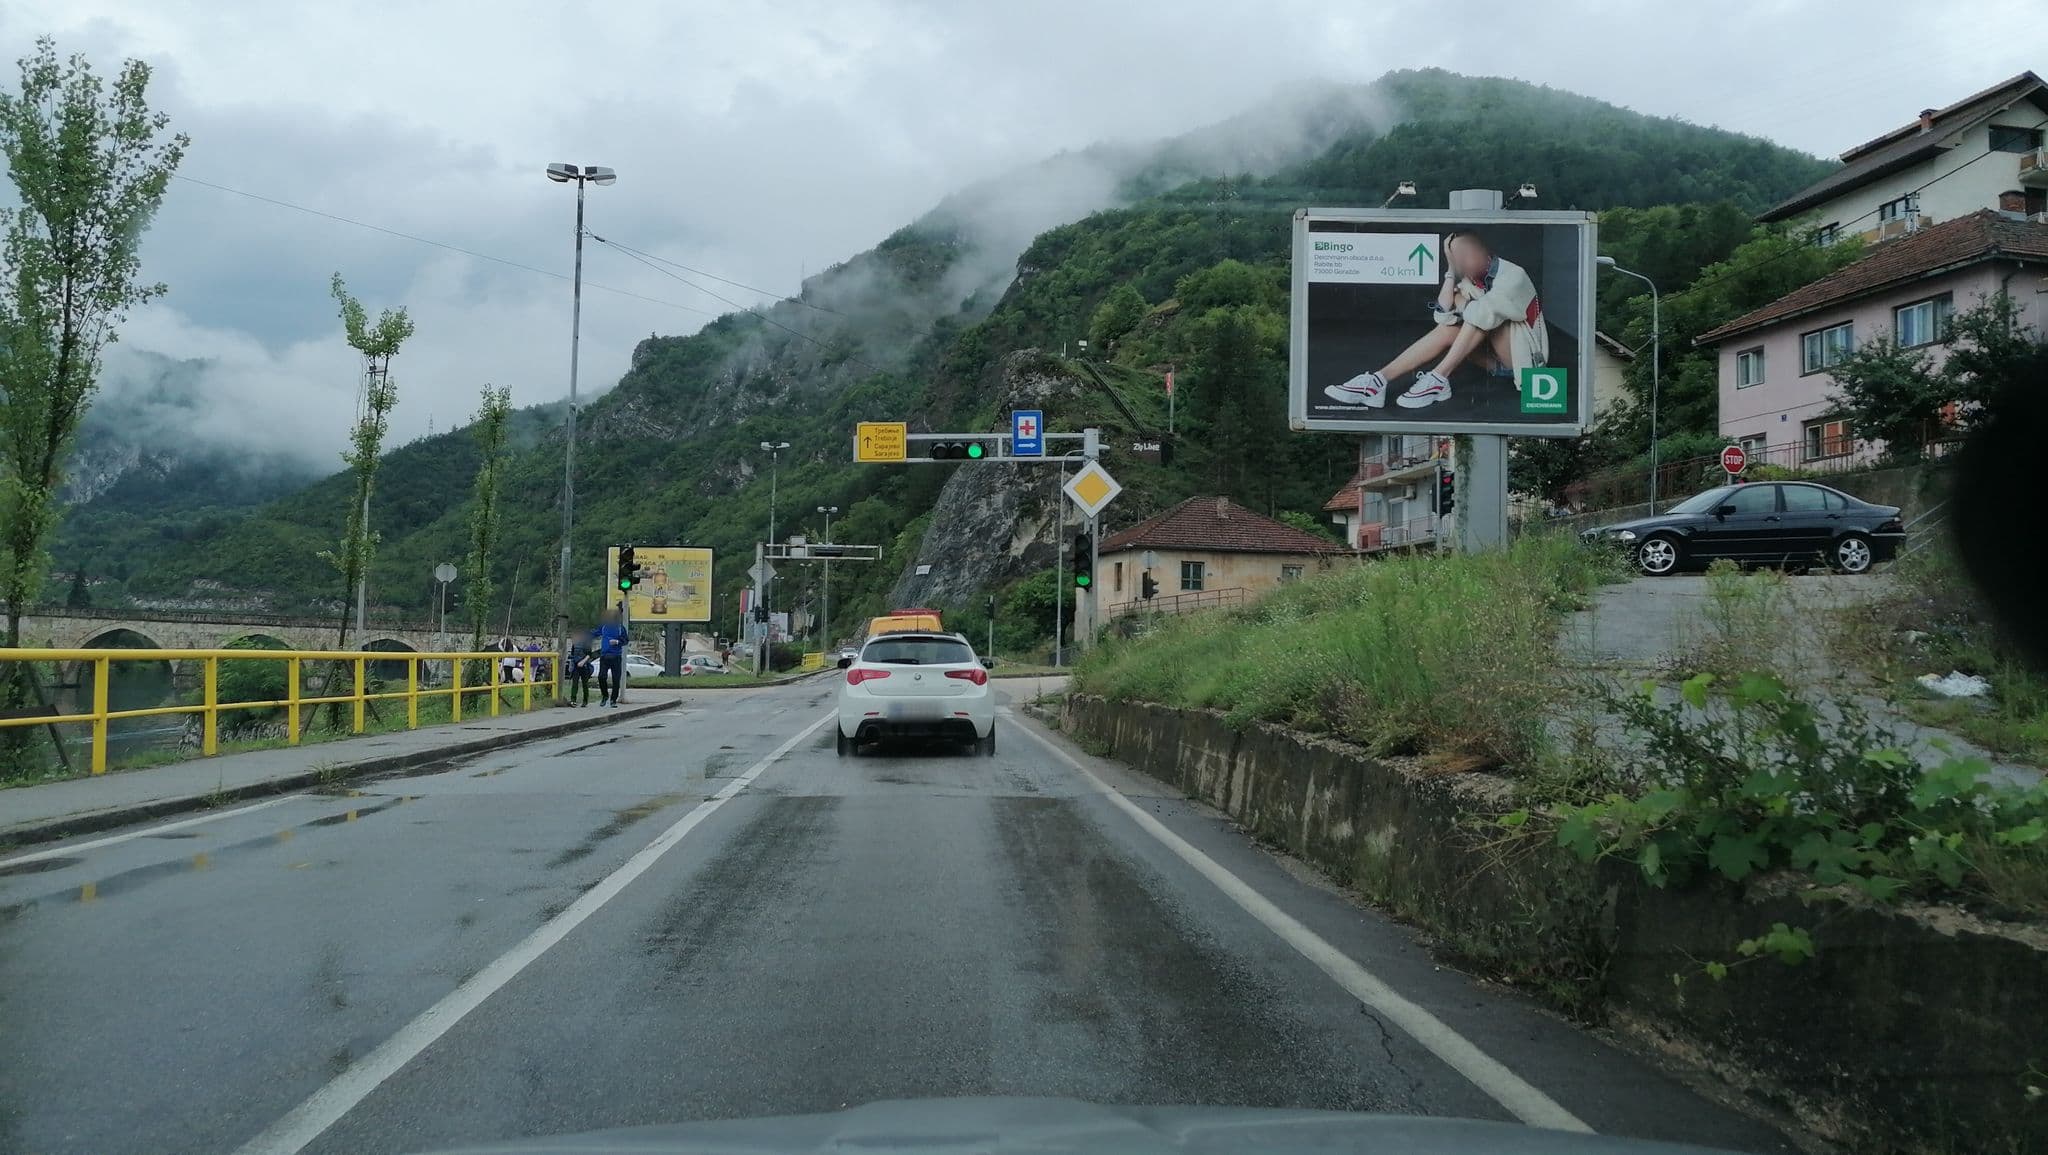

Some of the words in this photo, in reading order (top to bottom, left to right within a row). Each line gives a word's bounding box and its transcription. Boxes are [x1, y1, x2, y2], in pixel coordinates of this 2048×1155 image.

[1323, 241, 1354, 253] Bingo
[1380, 266, 1395, 276] 40
[1397, 265, 1416, 277] km
[1532, 374, 1559, 400] D
[874, 450, 900, 458] Sarajevo
[1725, 454, 1743, 464] STOP
